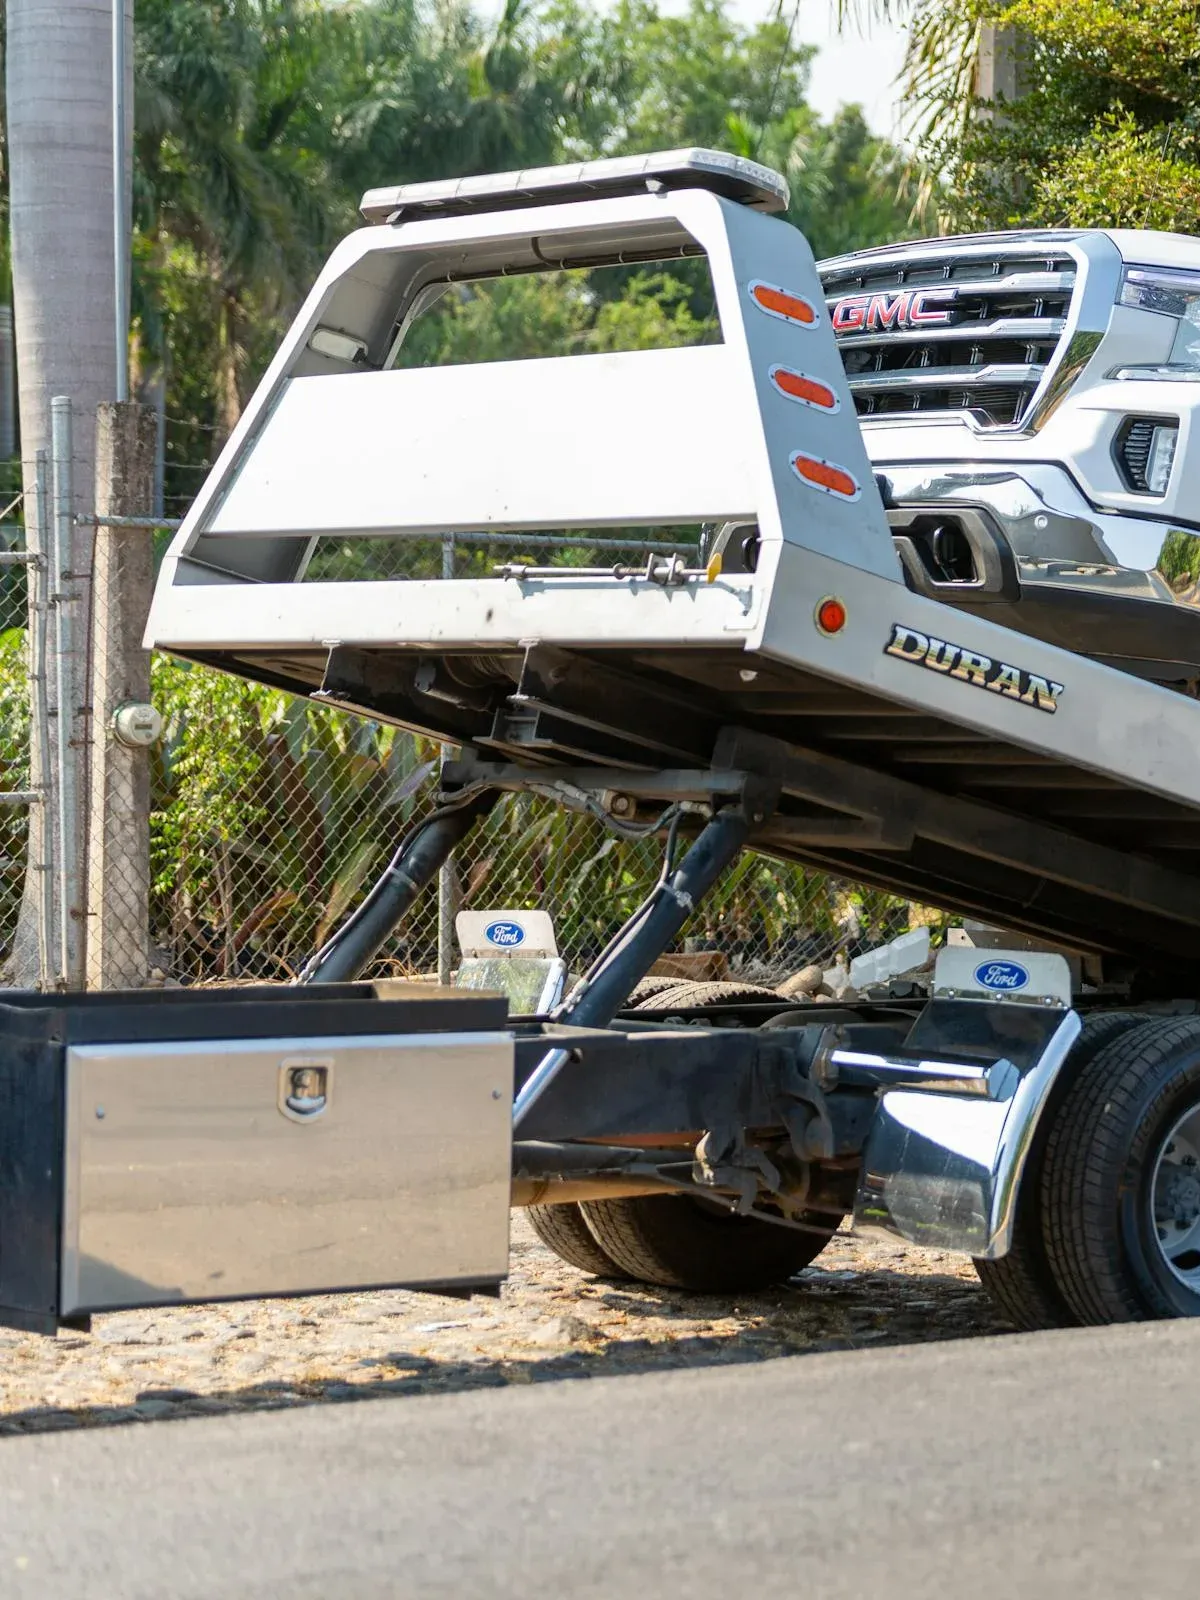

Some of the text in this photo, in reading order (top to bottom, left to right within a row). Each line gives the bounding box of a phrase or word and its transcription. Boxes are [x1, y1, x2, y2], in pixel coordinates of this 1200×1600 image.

[832, 288, 959, 330] GMC
[884, 623, 1065, 714] DURAN
[493, 925, 519, 944] Ford
[984, 965, 1019, 987] Ford
